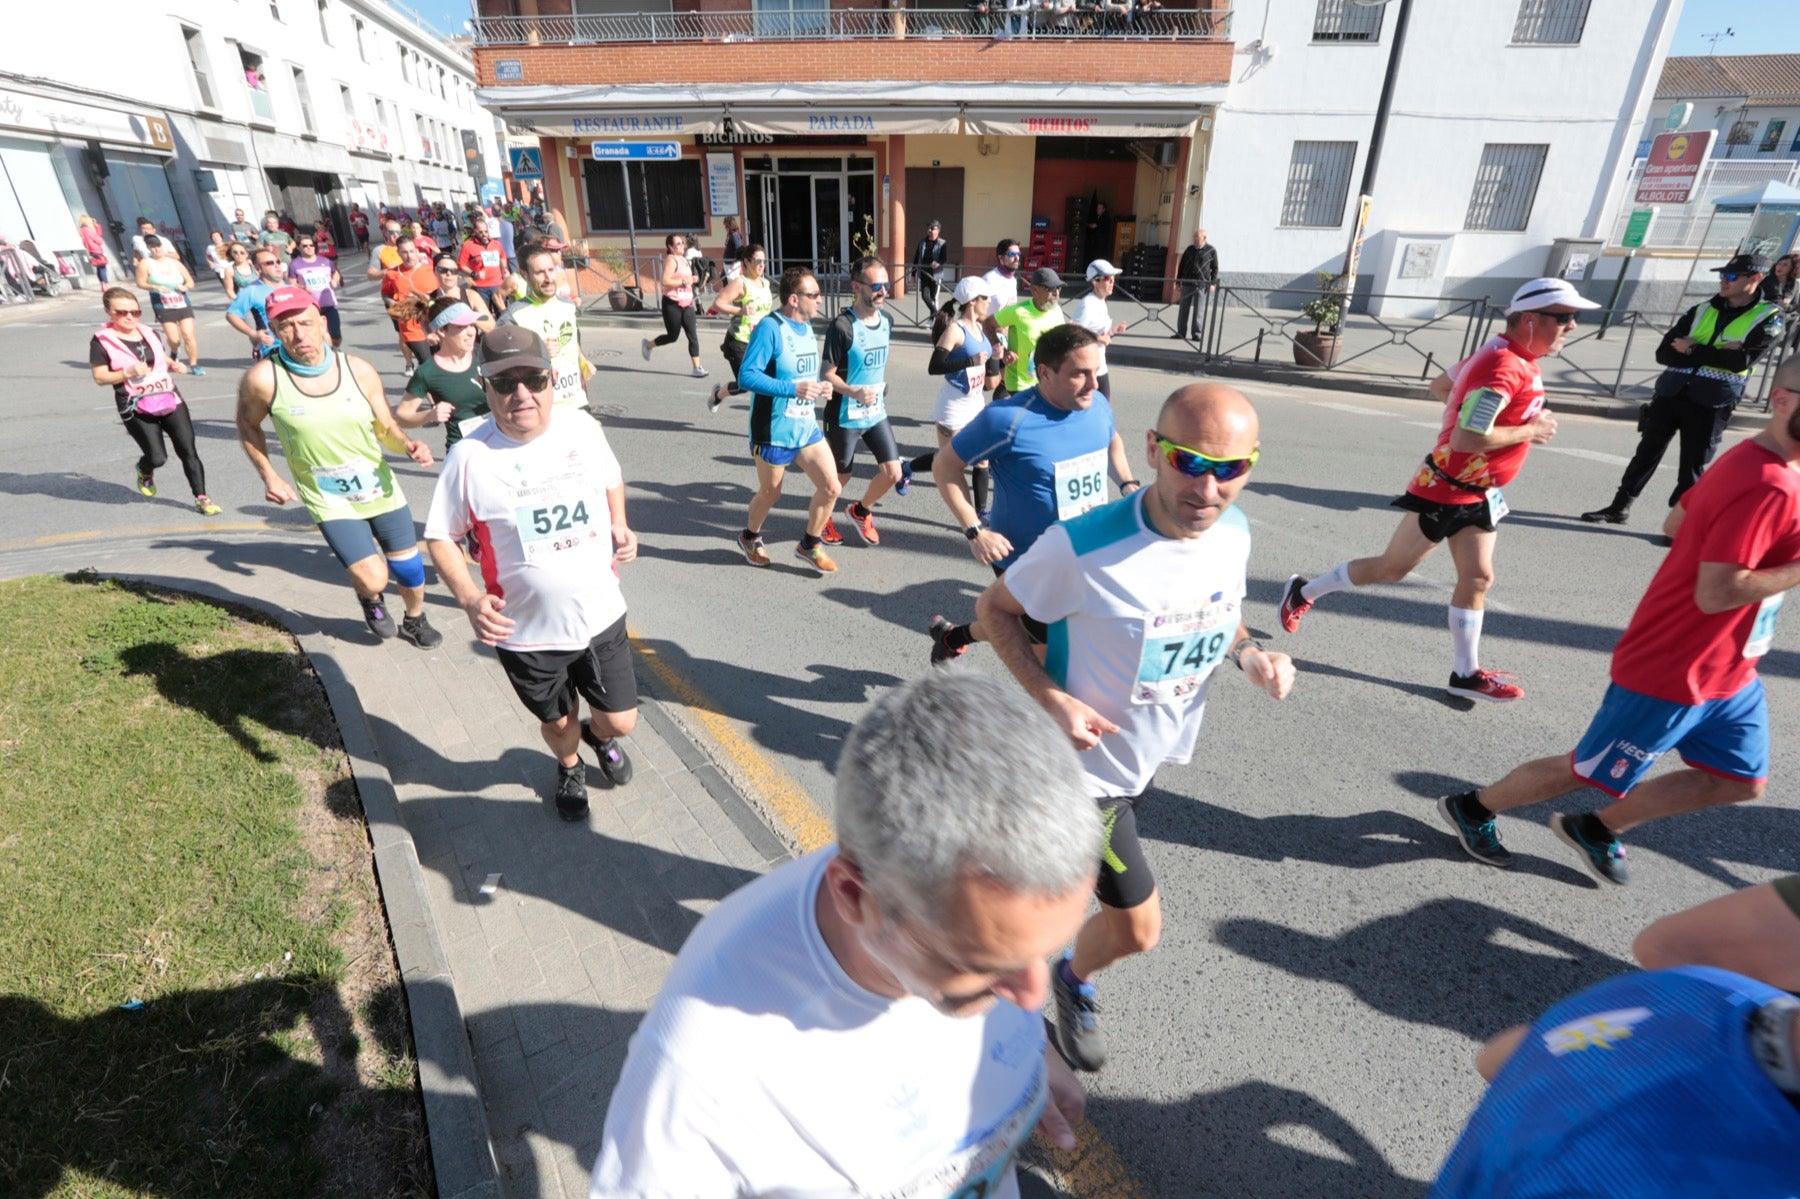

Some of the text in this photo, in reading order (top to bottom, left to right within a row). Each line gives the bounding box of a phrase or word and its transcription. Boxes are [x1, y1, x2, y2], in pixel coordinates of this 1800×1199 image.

[572, 115, 684, 132] RESTAURANTE
[809, 115, 875, 130] PARADA
[154, 122, 167, 144] B
[702, 132, 774, 144] BICHITOS
[594, 147, 630, 155] Granada
[1646, 163, 1698, 176] Gran apertura
[1638, 191, 1687, 201] ALBOLOTE
[335, 475, 362, 492] 31
[1068, 472, 1101, 500] 956
[533, 500, 589, 534] 524
[1164, 632, 1224, 674] 749
